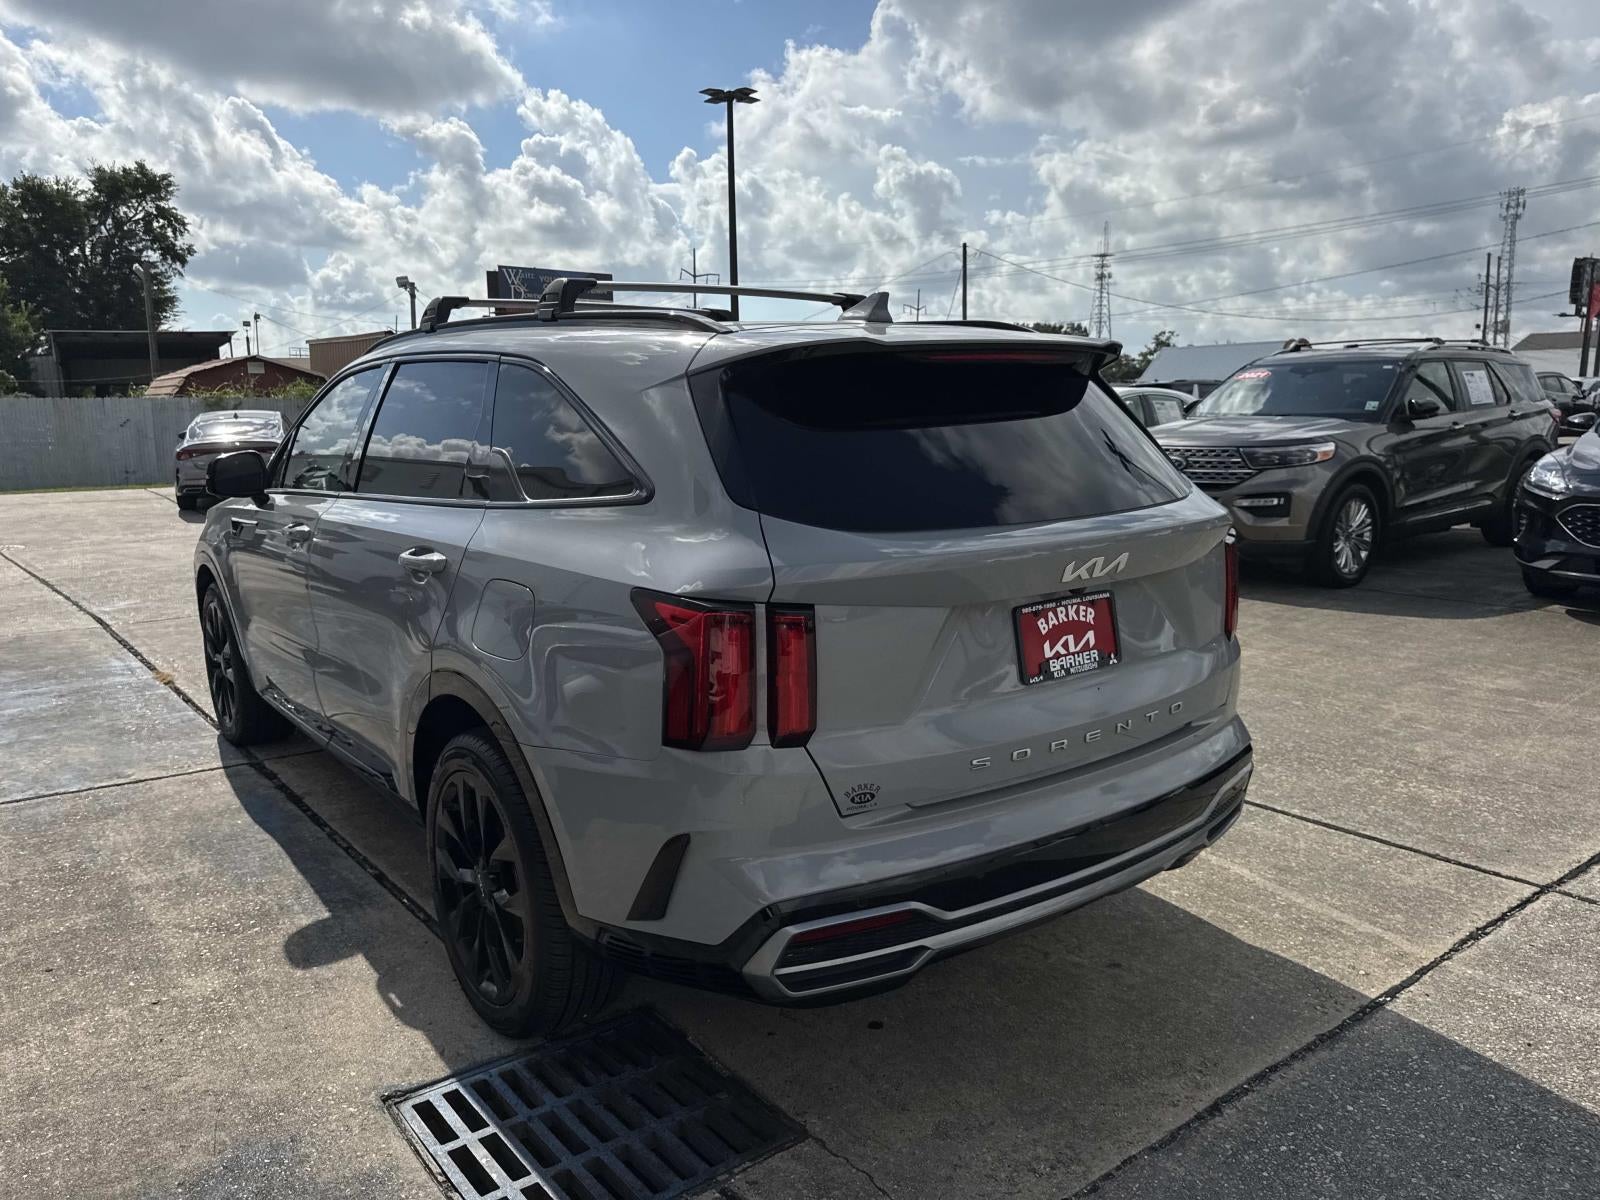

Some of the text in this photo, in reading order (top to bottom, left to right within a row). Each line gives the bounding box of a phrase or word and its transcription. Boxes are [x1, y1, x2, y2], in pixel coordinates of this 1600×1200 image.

[1062, 552, 1129, 582] KIA
[1037, 604, 1095, 635] BARKER
[1043, 629, 1096, 658] KIA
[1053, 670, 1066, 679] KIA
[970, 701, 1183, 770] SORENTO
[843, 783, 881, 799] BARKER
